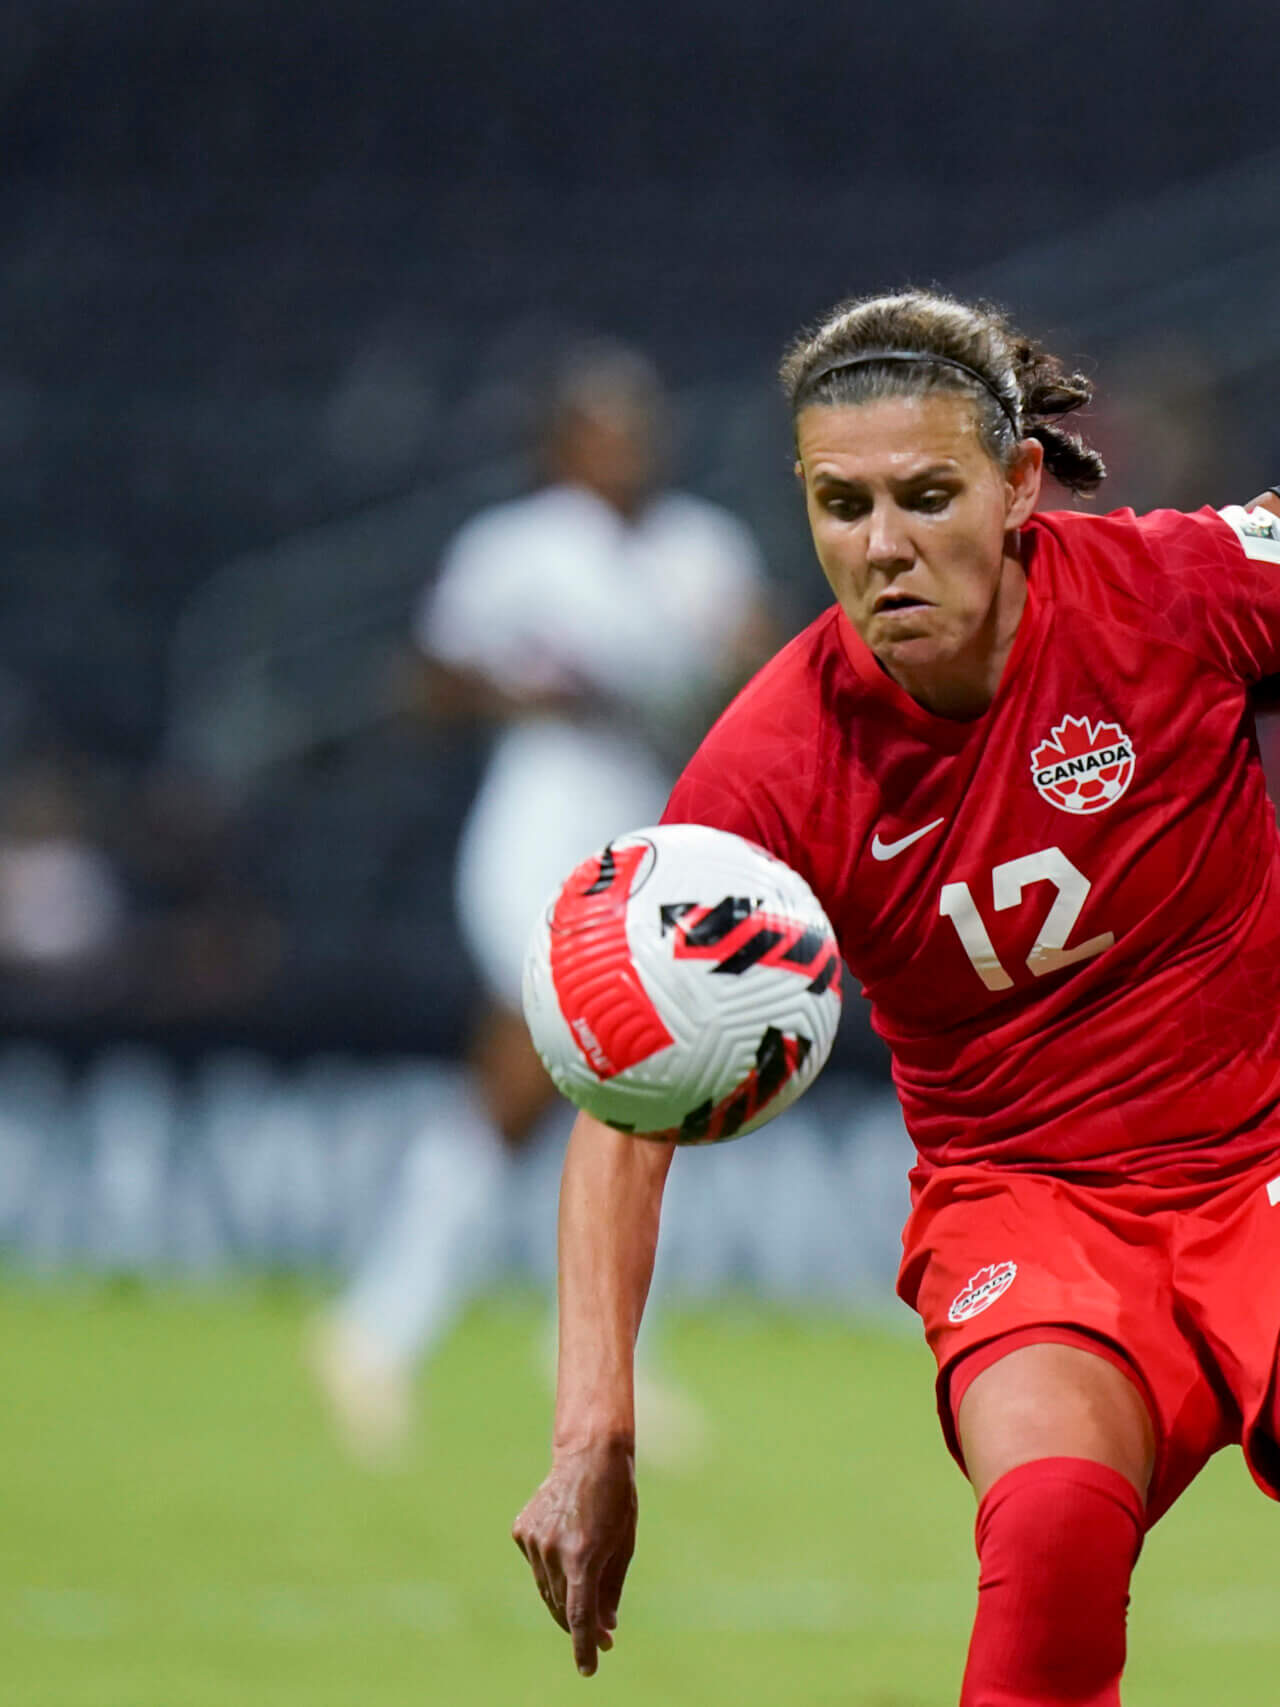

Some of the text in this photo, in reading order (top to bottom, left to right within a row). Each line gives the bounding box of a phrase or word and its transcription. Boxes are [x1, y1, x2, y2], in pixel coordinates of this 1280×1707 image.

[1037, 745, 1130, 786] CANADA
[939, 846, 1115, 991] 12
[951, 1271, 1012, 1315] CANADA
